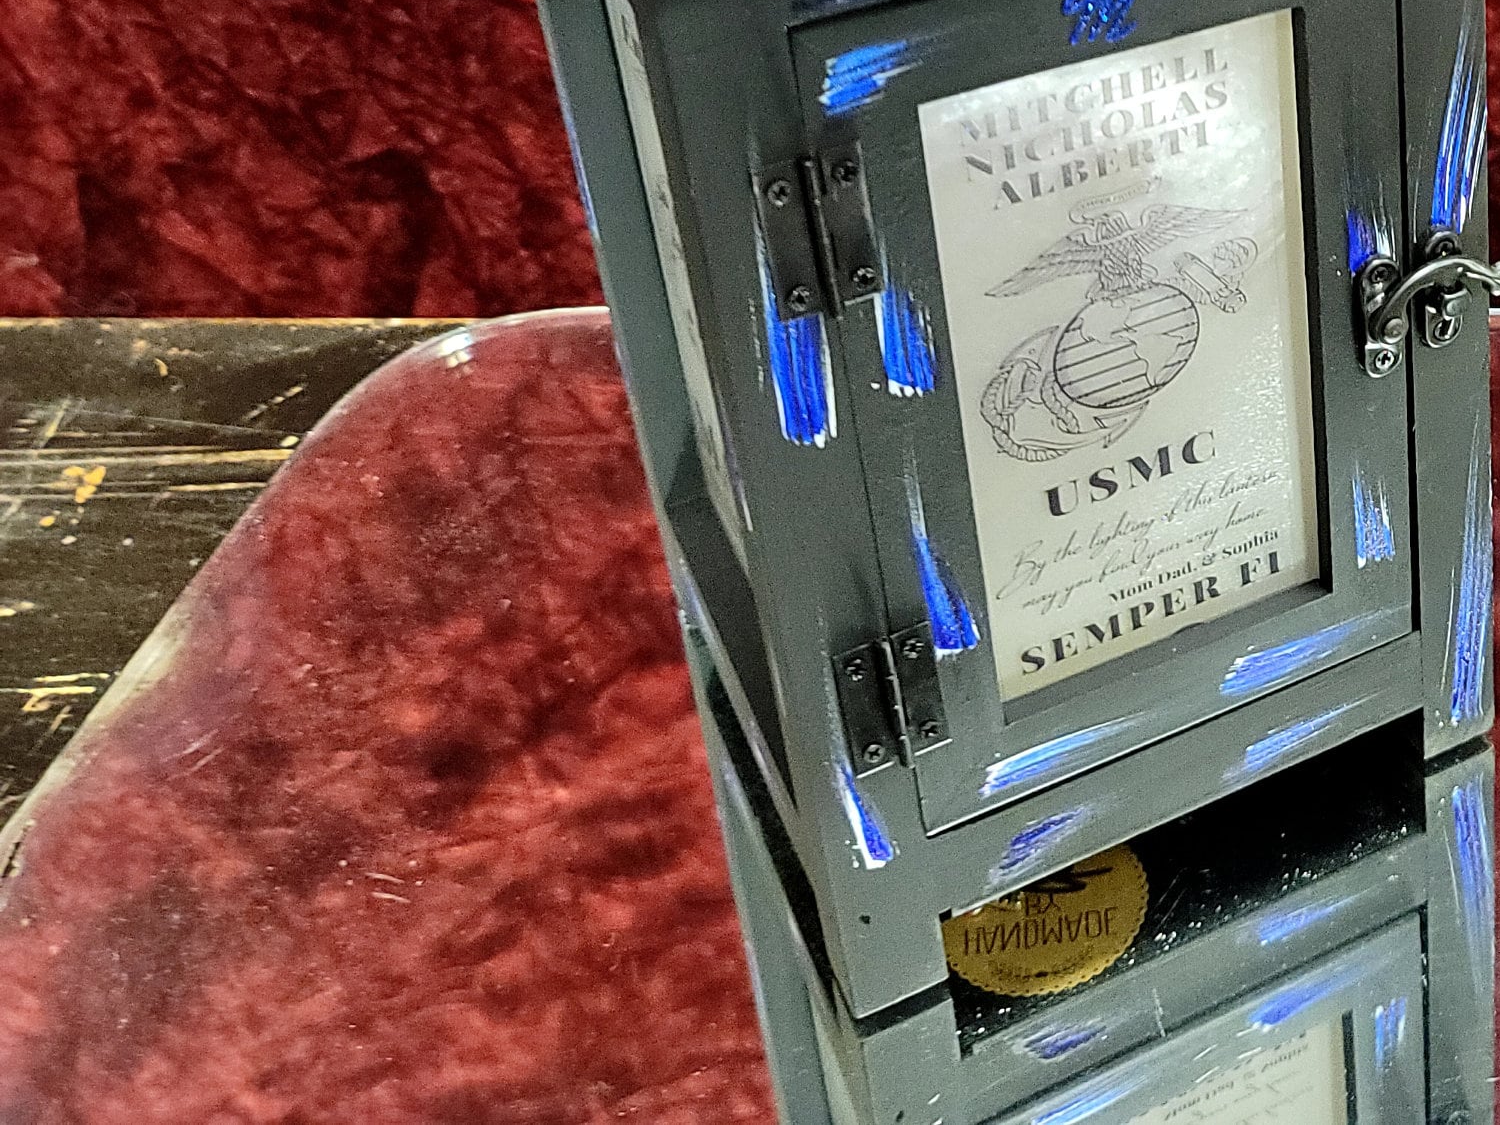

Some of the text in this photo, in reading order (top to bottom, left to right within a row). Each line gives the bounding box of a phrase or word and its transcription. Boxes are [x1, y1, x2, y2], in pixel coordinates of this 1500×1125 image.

[960, 47, 1229, 148] MITCHELL
[965, 81, 1229, 181] NICHOLAS
[993, 121, 1210, 210] ALBERTI
[1044, 430, 1217, 517] USMC
[1023, 590, 1058, 615] may
[1225, 501, 1267, 530] home
[1053, 530, 1082, 563] the
[1088, 510, 1155, 560] lighting
[1108, 581, 1153, 604] Mom
[1202, 552, 1217, 566] &
[1222, 529, 1279, 562] Sophia
[1021, 550, 1281, 676] SEMPER FI
